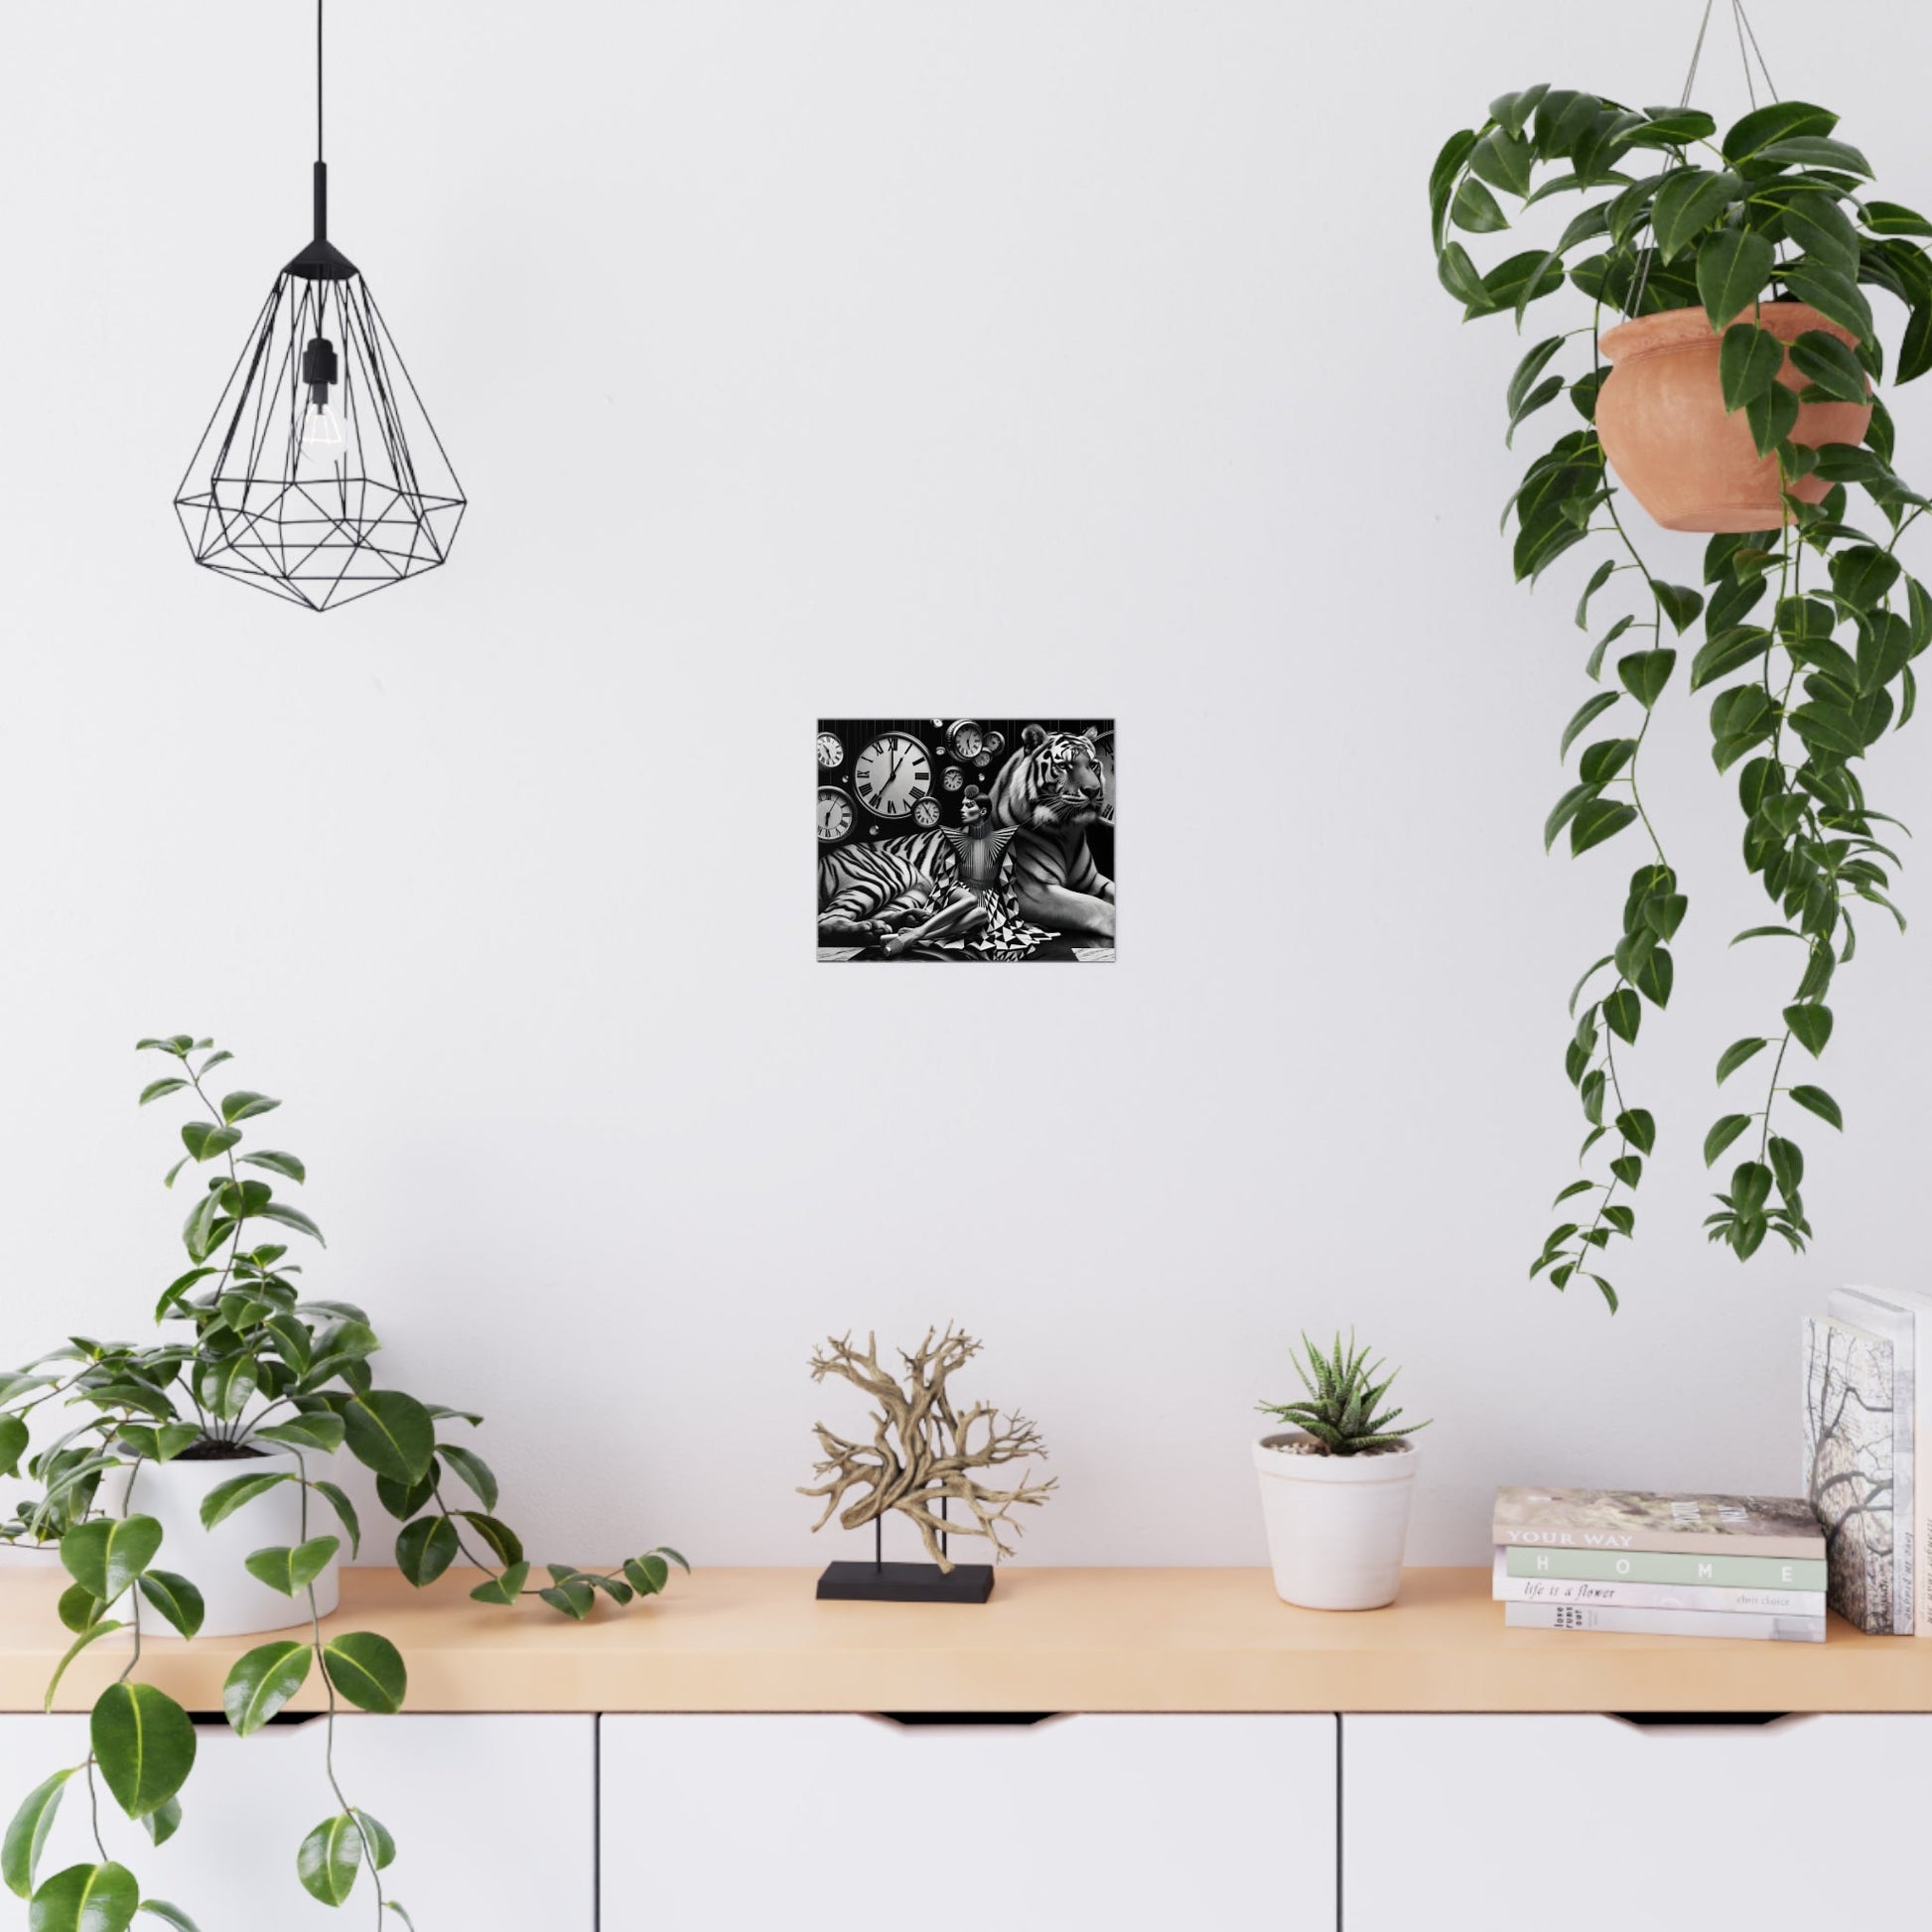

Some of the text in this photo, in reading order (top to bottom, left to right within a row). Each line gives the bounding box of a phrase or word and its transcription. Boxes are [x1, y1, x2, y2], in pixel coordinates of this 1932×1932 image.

[1508, 1530, 1633, 1548] YOUR WAY
[1524, 1581, 1545, 1599] life
[1550, 1586, 1560, 1596] is
[1575, 1584, 1615, 1601] flower
[1554, 1606, 1564, 1627] love
